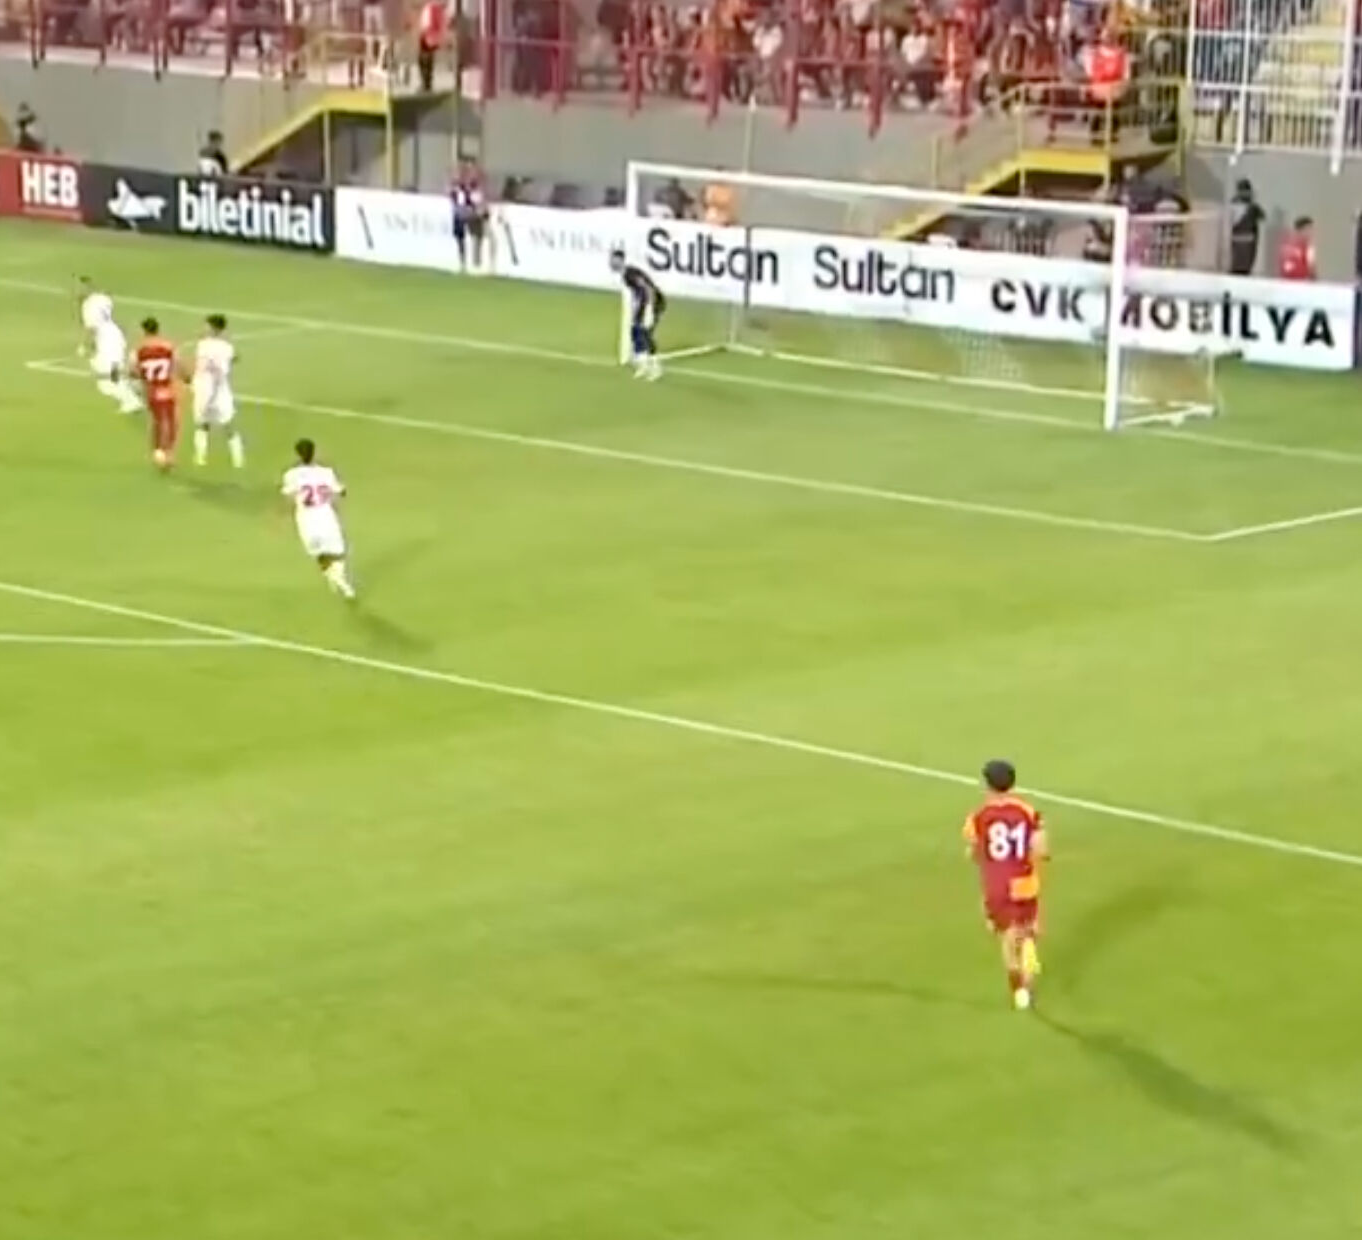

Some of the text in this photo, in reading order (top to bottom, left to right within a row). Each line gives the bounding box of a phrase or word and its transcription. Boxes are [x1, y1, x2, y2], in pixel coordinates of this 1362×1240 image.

[21, 160, 79, 208] HEB
[178, 178, 325, 246] biletinial
[647, 226, 779, 286] Sultan
[812, 244, 955, 303] Sultan
[990, 278, 1085, 322] CVK
[988, 820, 1028, 862] 81
